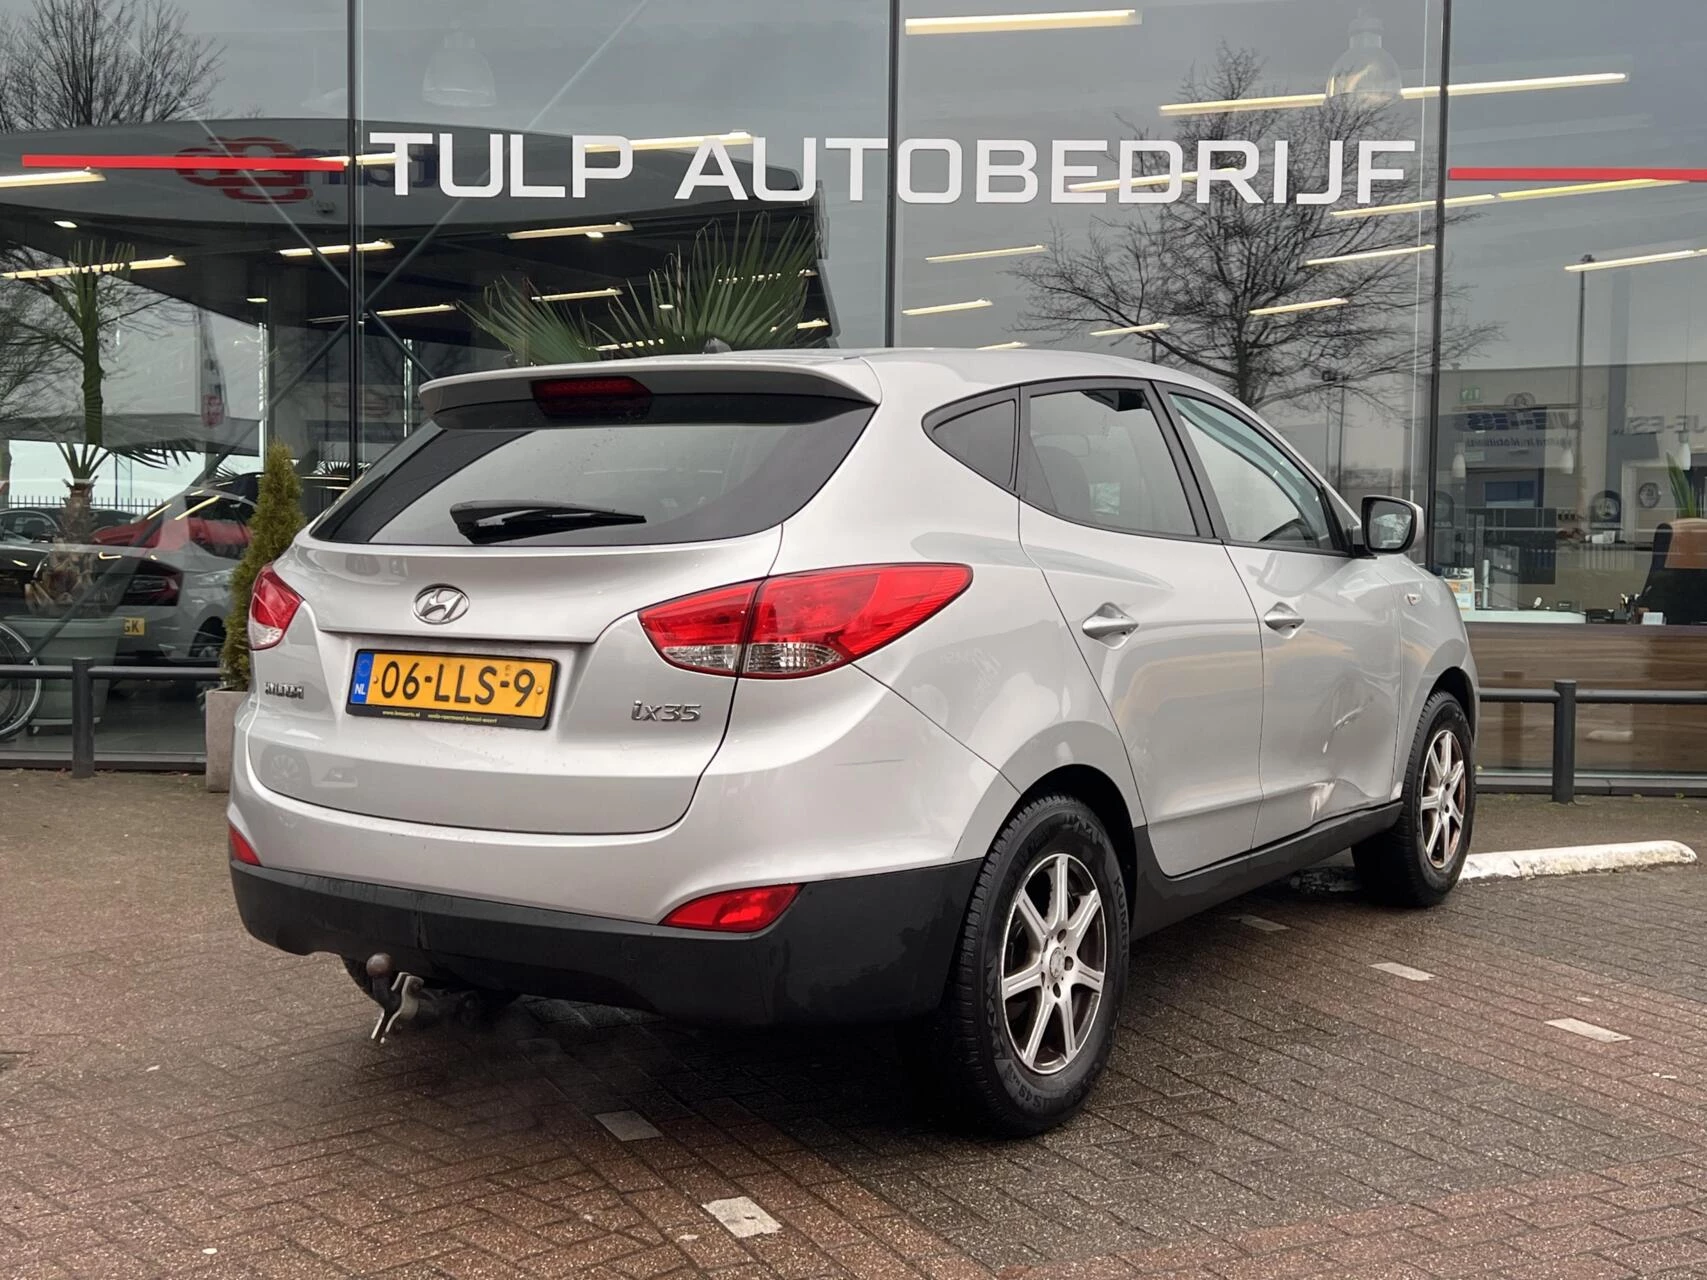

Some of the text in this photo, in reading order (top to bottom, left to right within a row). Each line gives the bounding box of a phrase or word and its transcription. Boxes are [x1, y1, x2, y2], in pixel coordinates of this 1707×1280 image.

[369, 132, 1416, 204] TULP AUTOBEDRIJF
[354, 683, 366, 696] NL
[381, 661, 536, 708] 06-LLS-9
[631, 700, 702, 722] ix35
